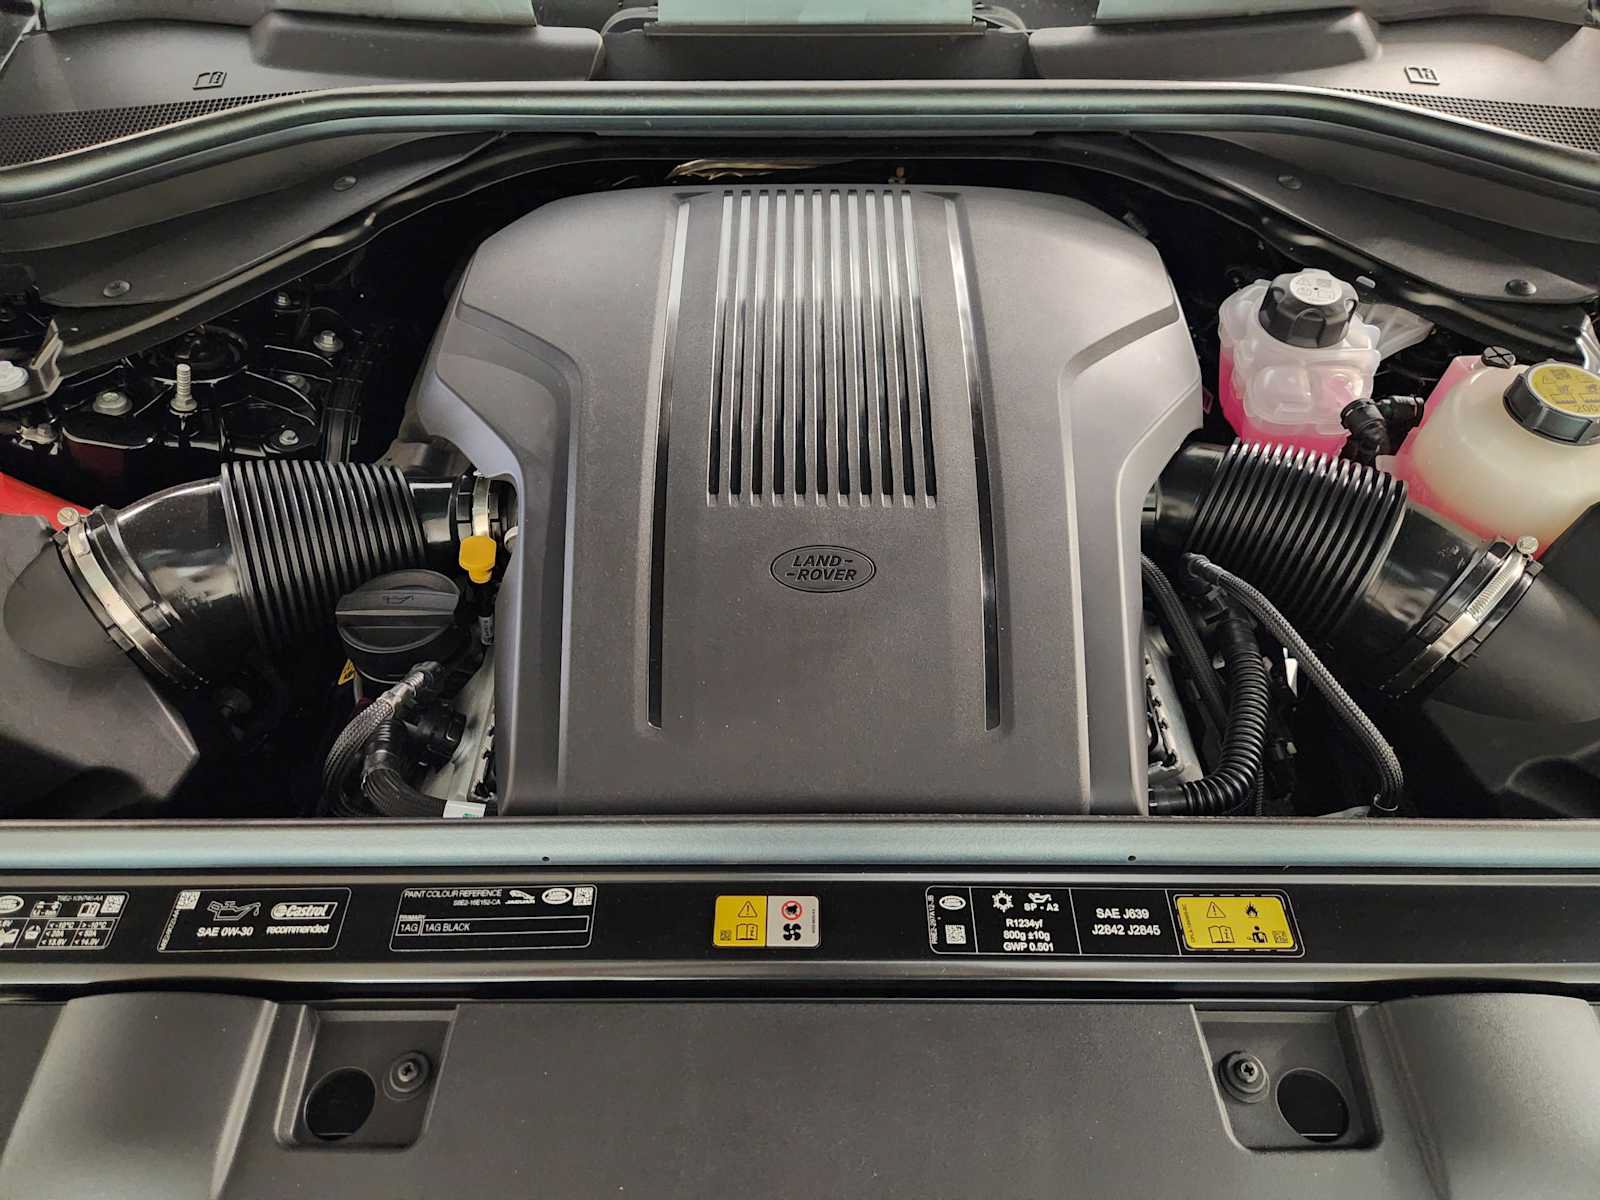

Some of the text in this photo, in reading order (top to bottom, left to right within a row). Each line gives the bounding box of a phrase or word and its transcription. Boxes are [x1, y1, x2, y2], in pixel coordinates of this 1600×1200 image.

[404, 889, 503, 898] PAINT COLOUR REFERENCE
[284, 904, 328, 917] Castrol
[1096, 908, 1150, 920] SAE J639
[197, 926, 254, 937] SAE 0W-30
[266, 924, 330, 935] recommended
[400, 923, 418, 933] 1AG
[424, 922, 471, 932] 1AG BLACK
[1003, 942, 1028, 951] GWP
